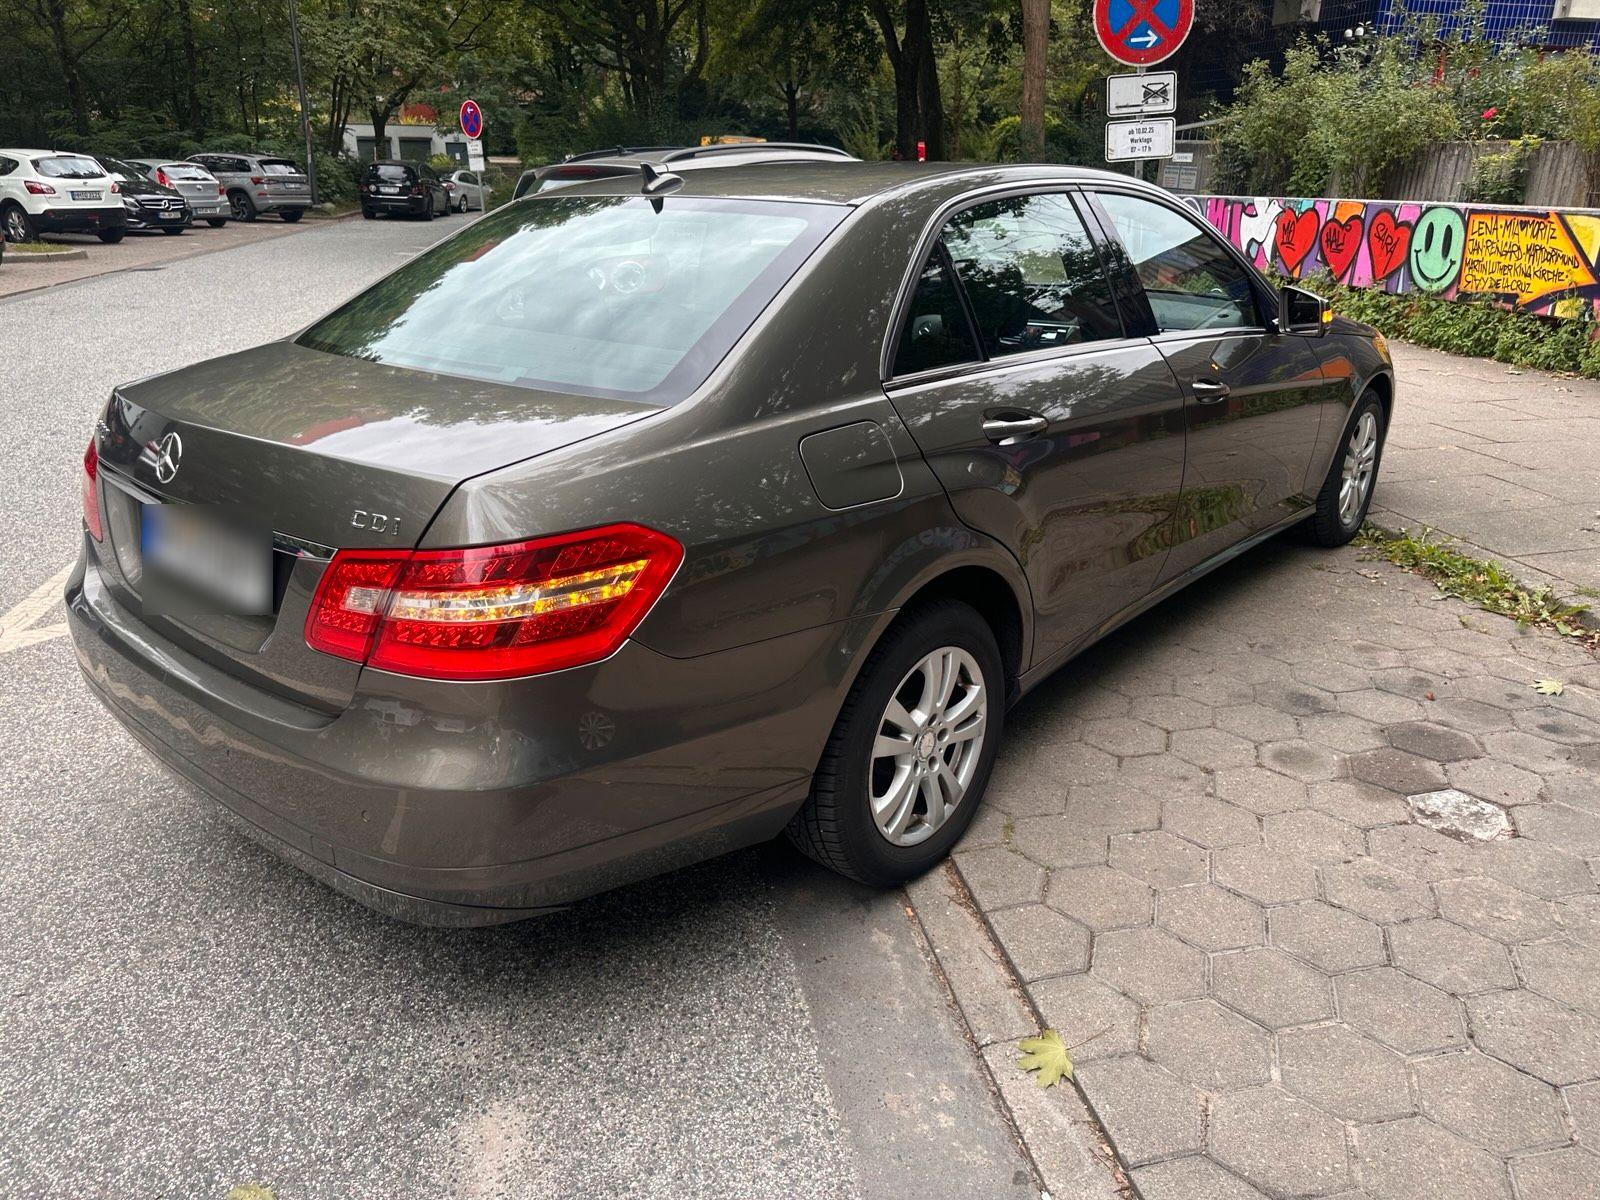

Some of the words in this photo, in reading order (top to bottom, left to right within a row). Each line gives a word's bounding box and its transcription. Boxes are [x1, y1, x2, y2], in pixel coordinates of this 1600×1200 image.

[1471, 216, 1498, 239] LENA
[1525, 220, 1557, 244] MORITZ
[1375, 223, 1400, 270] SARA
[1465, 257, 1487, 275] MARTIN
[1488, 261, 1513, 277] LUTHER
[1513, 263, 1531, 280] KING
[1510, 280, 1533, 293] CRUZ
[351, 510, 401, 535] CDI
